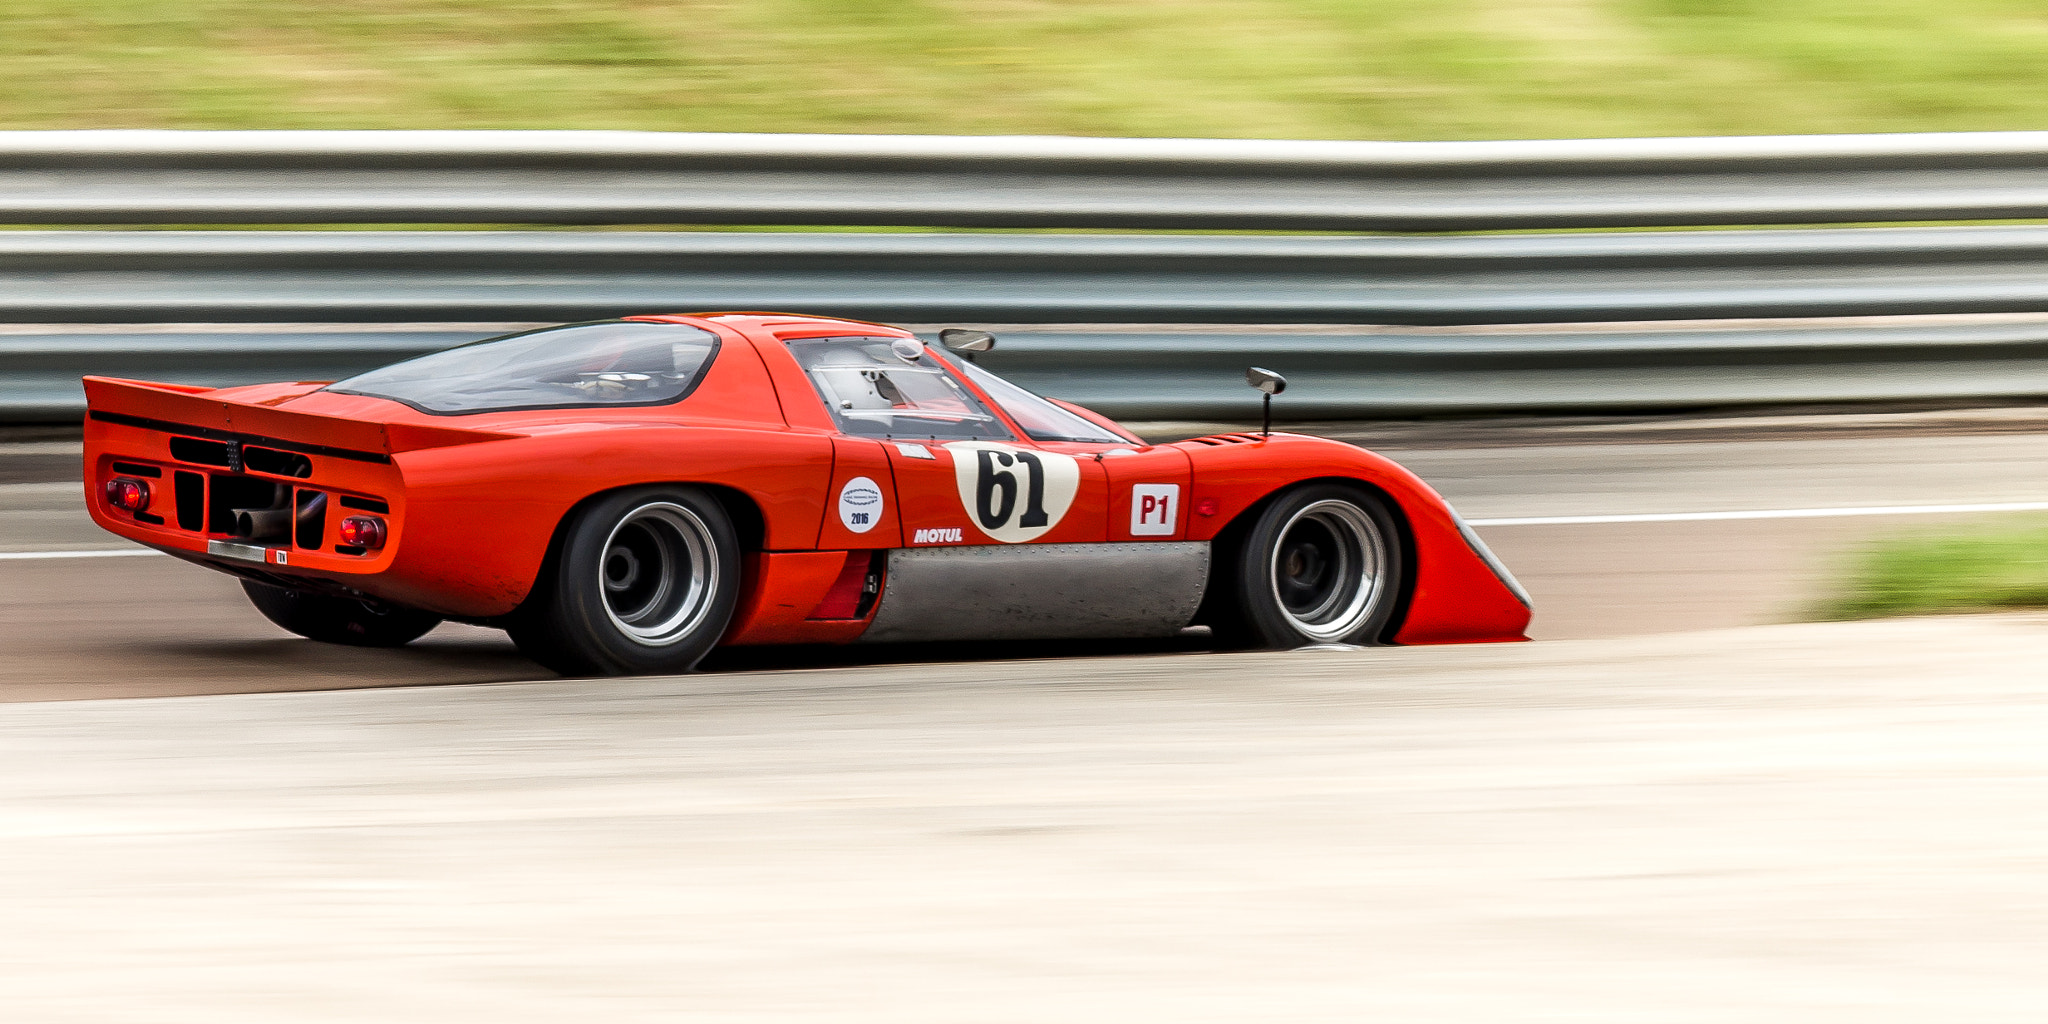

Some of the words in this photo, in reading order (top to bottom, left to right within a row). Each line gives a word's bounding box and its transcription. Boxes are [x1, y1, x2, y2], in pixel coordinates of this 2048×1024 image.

[977, 450, 1048, 529] 61
[851, 513, 869, 524] 2016
[1141, 495, 1168, 524] P1
[914, 528, 962, 543] MOTUL
